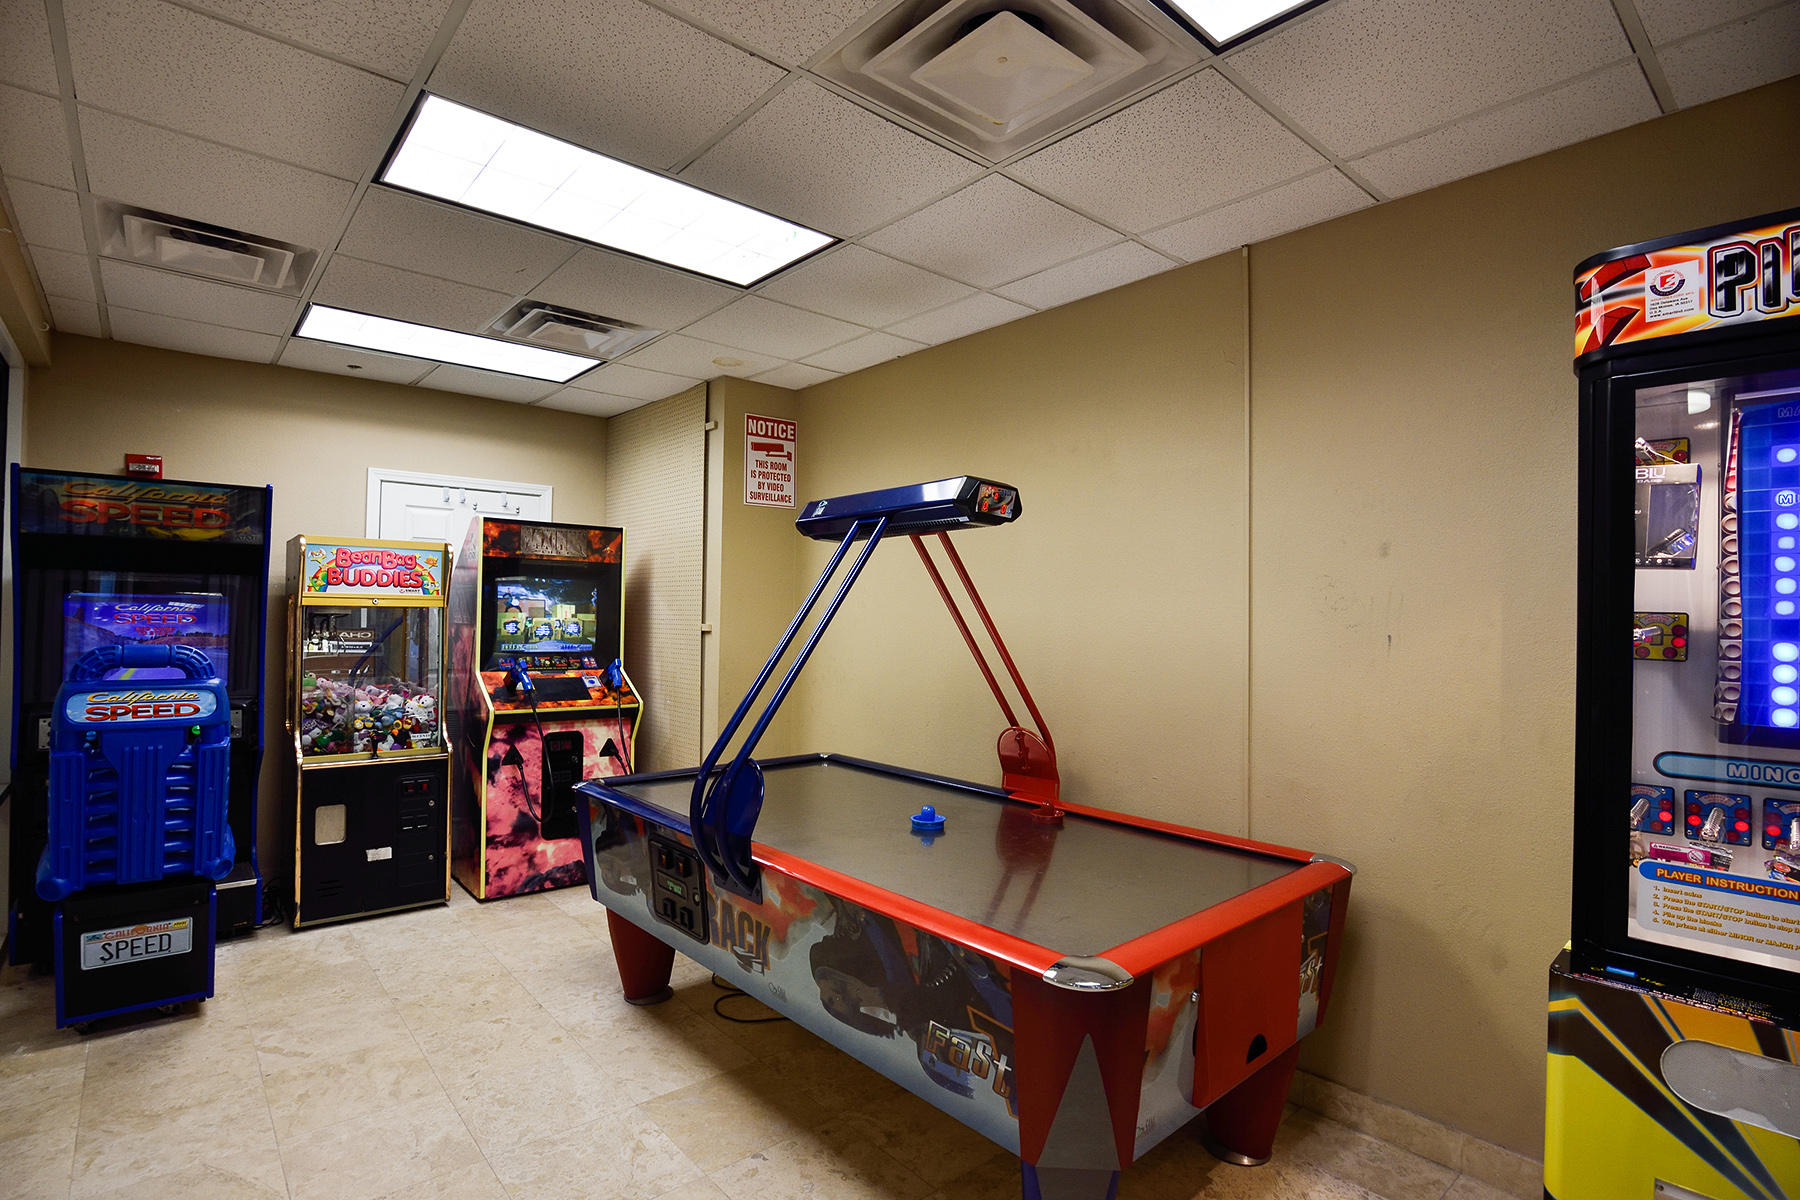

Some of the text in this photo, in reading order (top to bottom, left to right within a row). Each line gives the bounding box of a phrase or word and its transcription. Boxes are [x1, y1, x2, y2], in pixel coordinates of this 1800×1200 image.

[1707, 223, 1800, 318] PI
[748, 419, 795, 439] NOTICE
[755, 460, 787, 471] THIS ROOM
[751, 469, 791, 482] IS PROTECTED
[62, 481, 229, 504] California
[757, 481, 784, 492] BY VIDEO
[750, 491, 792, 503] SURVEILLANCE
[60, 499, 231, 528] SPEED
[326, 567, 424, 588] BUDDIES
[114, 603, 196, 614] California
[113, 613, 197, 624] SPEED
[87, 690, 199, 706] California
[85, 703, 200, 721] SPEED
[1656, 868, 1800, 901] PLAYER INSTRUCTION
[1696, 909, 1743, 923] START/STOP
[1697, 901, 1744, 914] START/STOP
[708, 891, 771, 970] RACK
[100, 933, 171, 961] SPEED
[925, 1020, 1012, 1098] Fast
